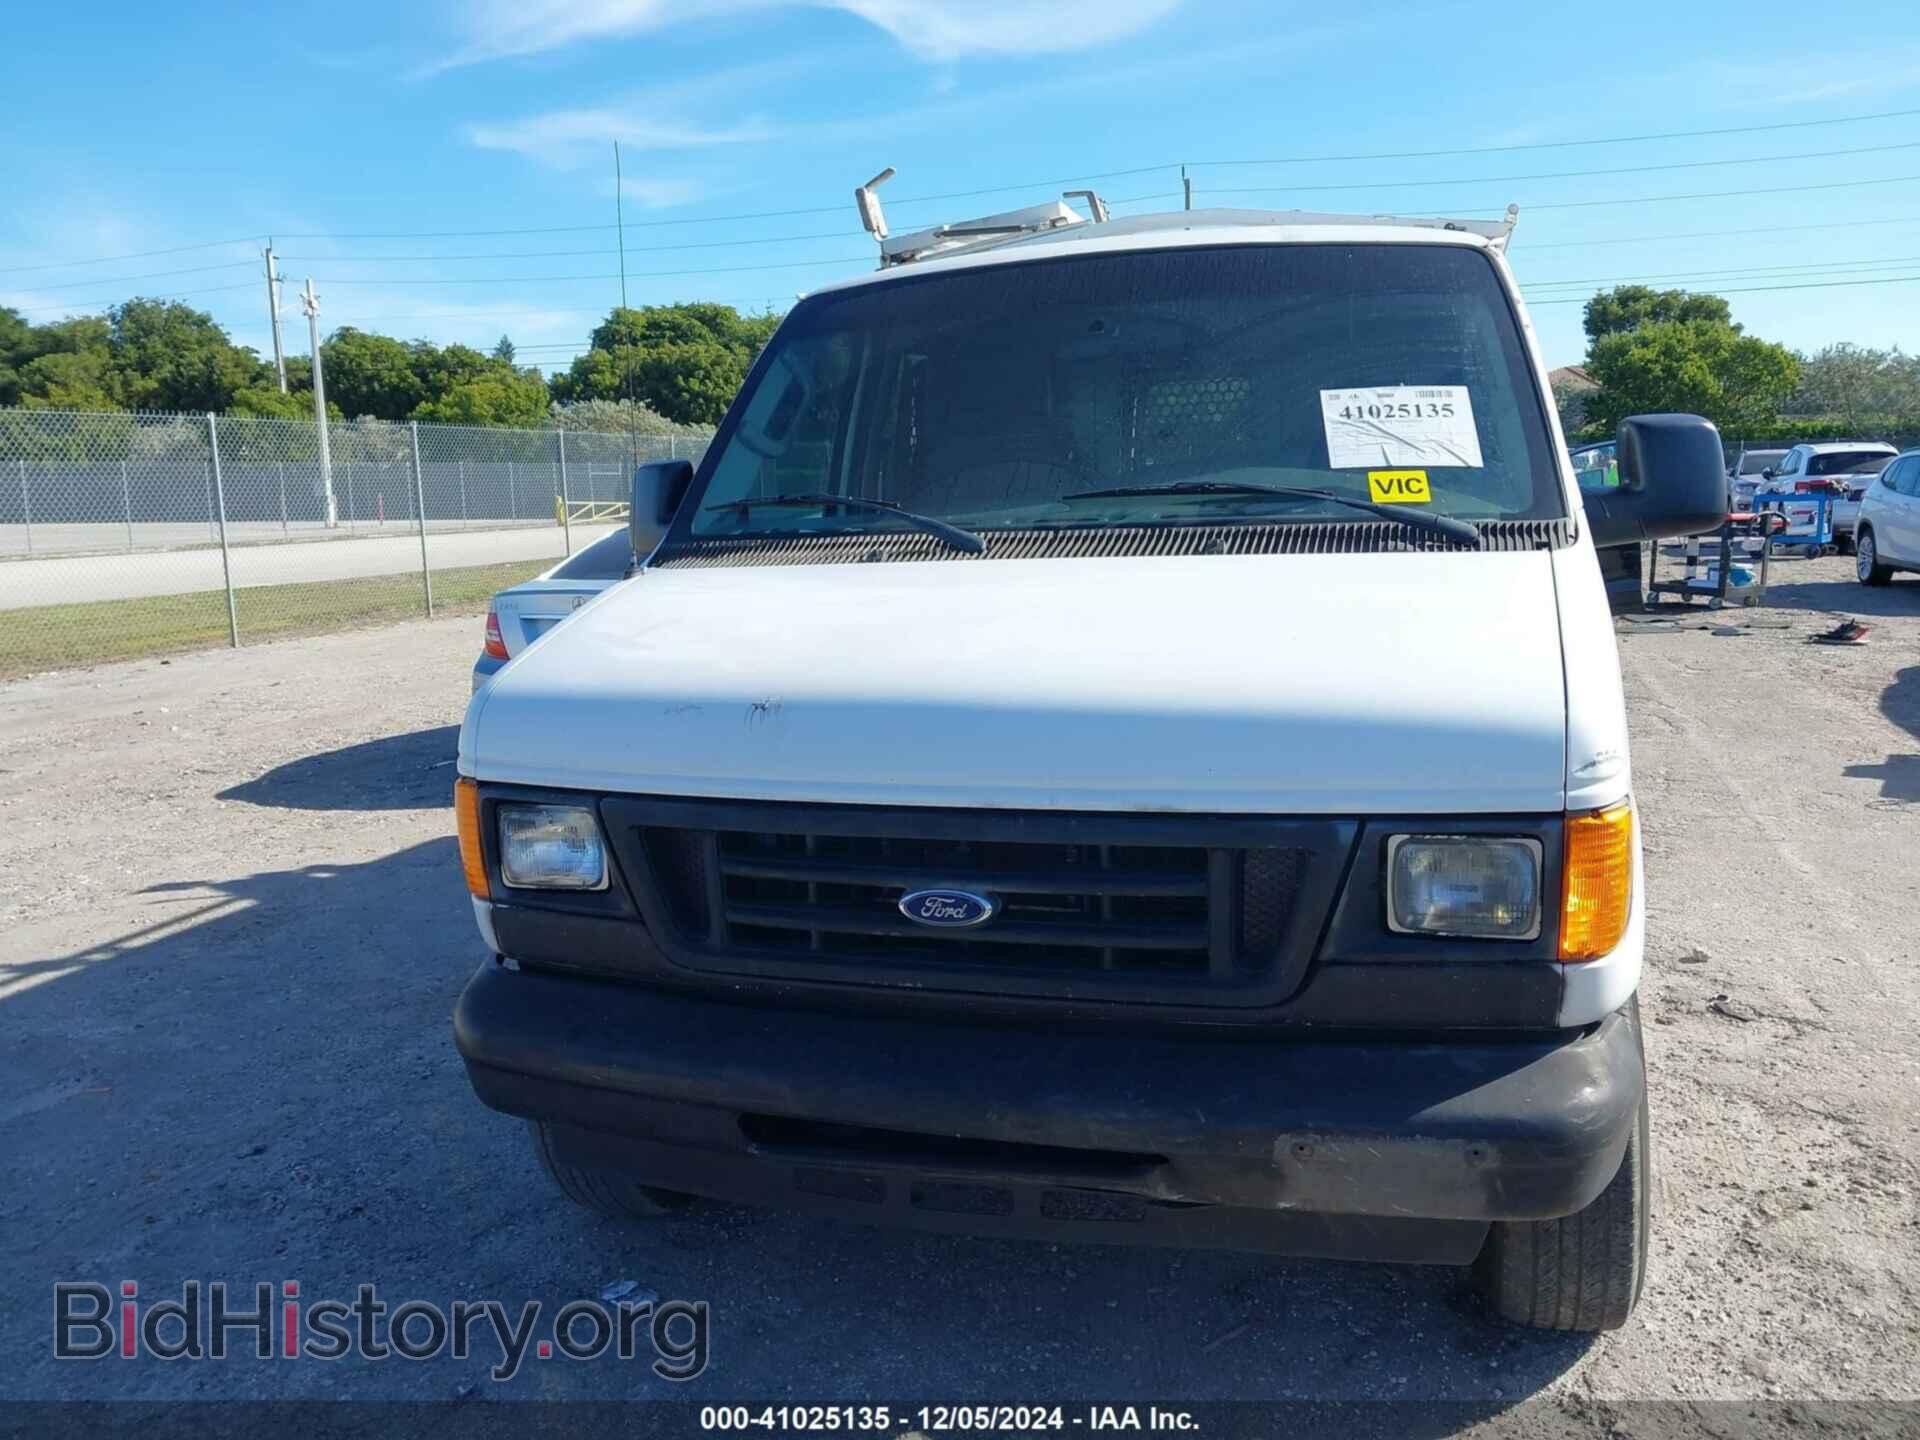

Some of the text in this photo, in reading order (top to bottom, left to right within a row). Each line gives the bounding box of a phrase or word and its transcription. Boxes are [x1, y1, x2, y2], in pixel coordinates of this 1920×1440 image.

[1339, 403, 1455, 419] 41025135
[1374, 478, 1425, 495] VIC
[920, 896, 968, 918] Ford
